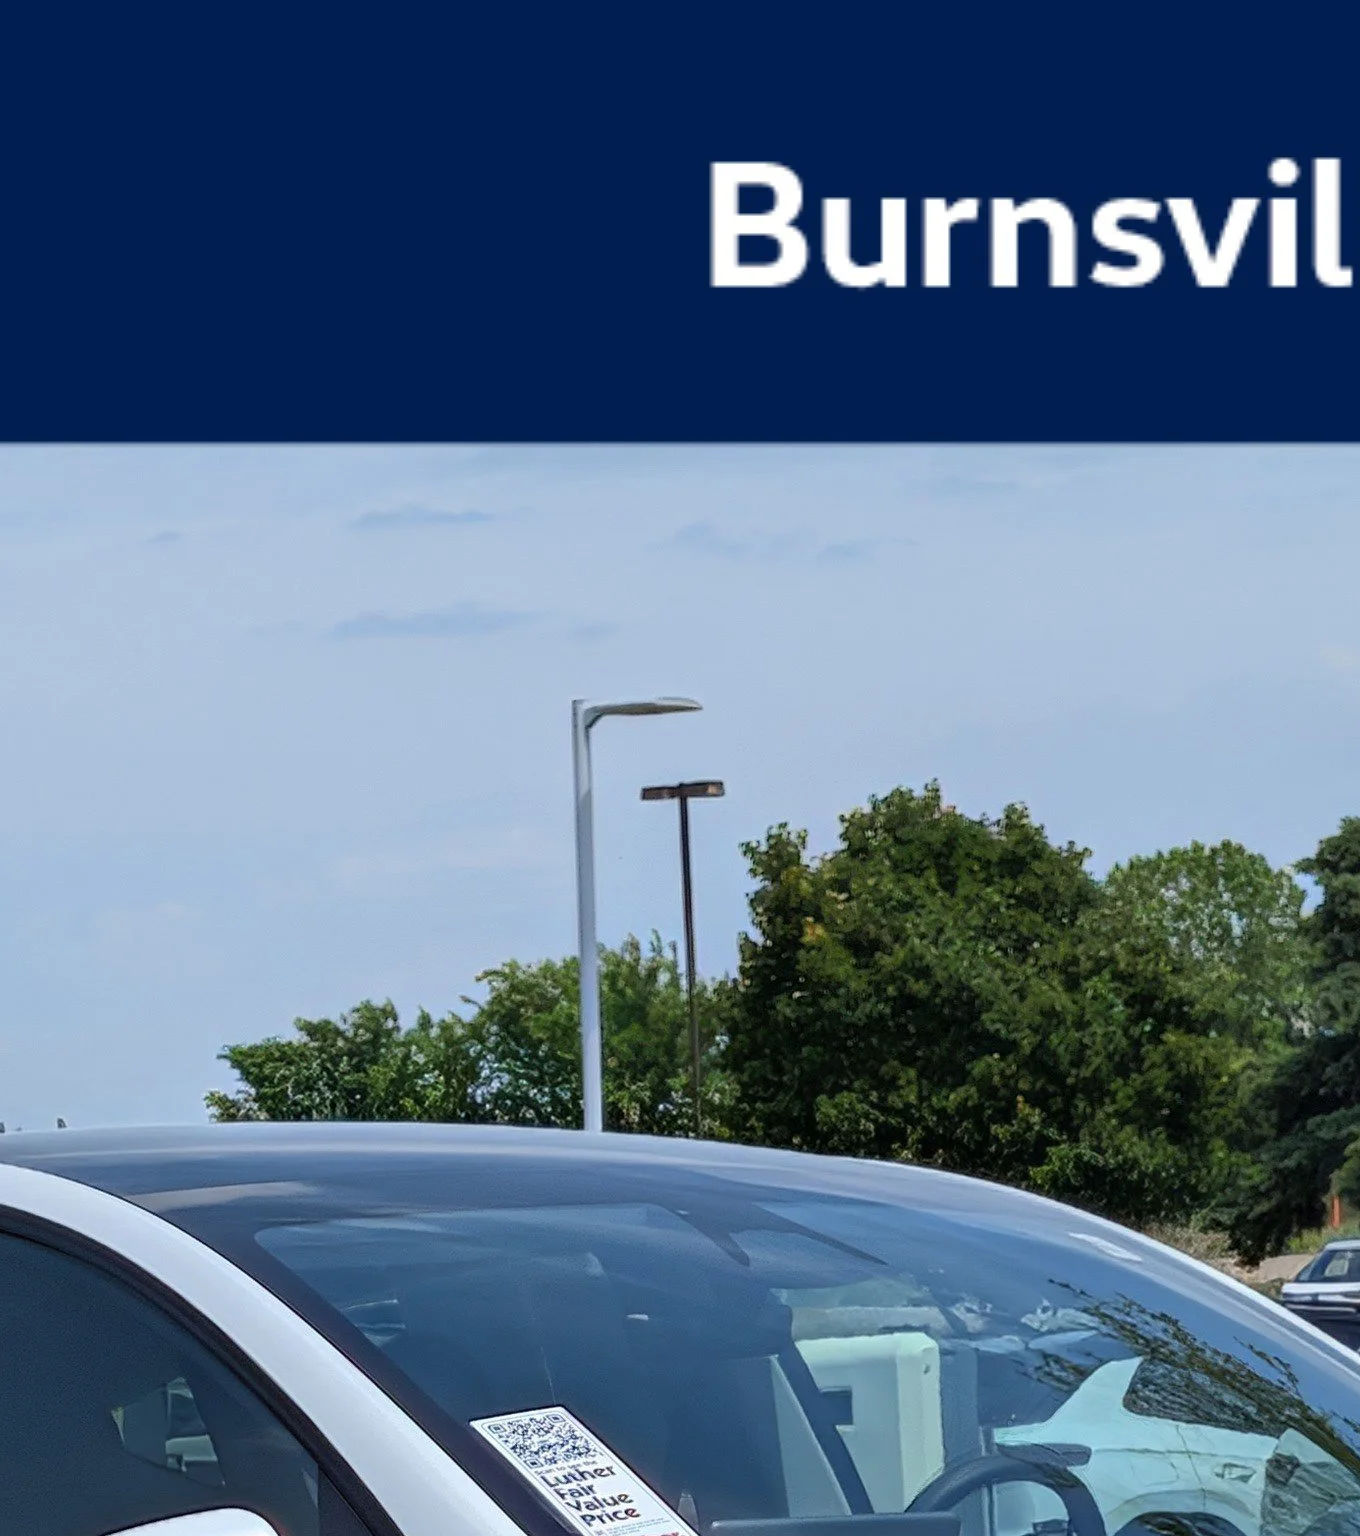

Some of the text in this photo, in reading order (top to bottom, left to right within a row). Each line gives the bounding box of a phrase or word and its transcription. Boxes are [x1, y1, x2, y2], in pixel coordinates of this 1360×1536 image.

[540, 1465, 616, 1488] Luther
[553, 1484, 597, 1500] Fair
[564, 1493, 634, 1512] Value
[580, 1508, 642, 1527] Price
